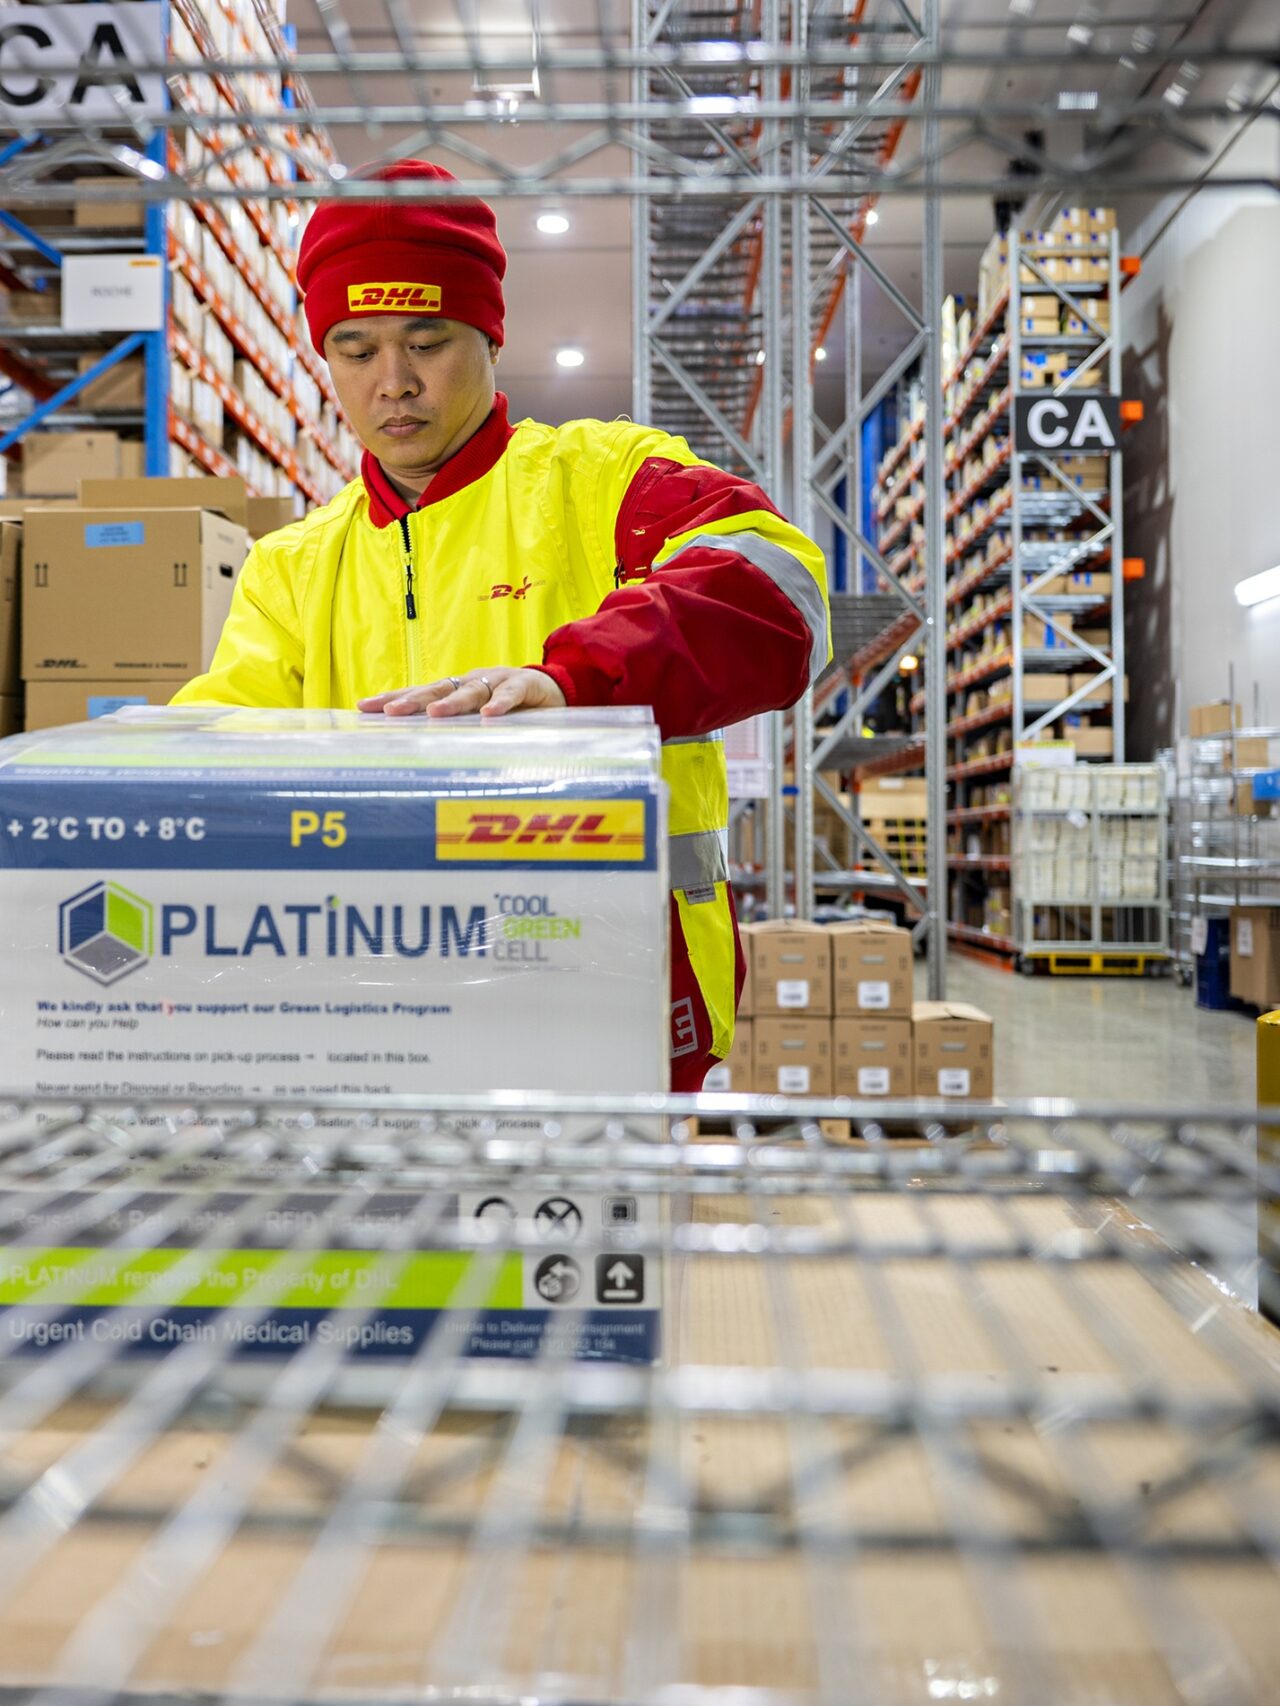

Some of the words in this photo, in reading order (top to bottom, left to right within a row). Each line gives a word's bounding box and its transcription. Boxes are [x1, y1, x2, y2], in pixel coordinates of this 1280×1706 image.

[357, 287, 429, 306] DHL
[1027, 398, 1116, 448] CA
[7, 819, 23, 838] +
[31, 817, 79, 840] 2°C
[86, 817, 126, 840] TO
[133, 820, 150, 838] +
[158, 817, 206, 841] 8°C
[290, 810, 348, 848] P5
[466, 814, 615, 844] DHL
[503, 916, 582, 940] GREEN
[493, 940, 550, 962] CELL
[37, 1001, 57, 1012] We
[61, 1000, 103, 1014] kindly
[108, 1001, 131, 1012] ask
[136, 1002, 163, 1012] that
[167, 1004, 192, 1016] you
[196, 1002, 248, 1015] support
[253, 1004, 275, 1013] our
[280, 1002, 321, 1014] Green
[325, 1003, 388, 1017] Logistics
[393, 1004, 452, 1017] Program
[37, 1018, 62, 1028] How
[65, 1019, 86, 1028] can
[89, 1020, 108, 1030] you
[113, 1018, 139, 1030] Help
[37, 1050, 75, 1061] Please
[78, 1051, 103, 1061] read
[107, 1051, 123, 1061] the
[129, 1051, 191, 1062] instructions
[194, 1053, 207, 1062] on
[255, 1053, 300, 1064] process
[327, 1052, 369, 1063] located
[373, 1053, 381, 1063] in
[385, 1053, 404, 1063] this
[10, 1265, 119, 1287] PLATINUM
[207, 1269, 237, 1287] the
[330, 1268, 350, 1288] of
[355, 1269, 398, 1288] DHL
[9, 1320, 84, 1346] Urgent
[91, 1319, 143, 1341] Cold
[149, 1319, 216, 1342] Chain
[224, 1320, 310, 1343] Medical
[316, 1320, 415, 1349] Supplies
[471, 1337, 511, 1350] Please
